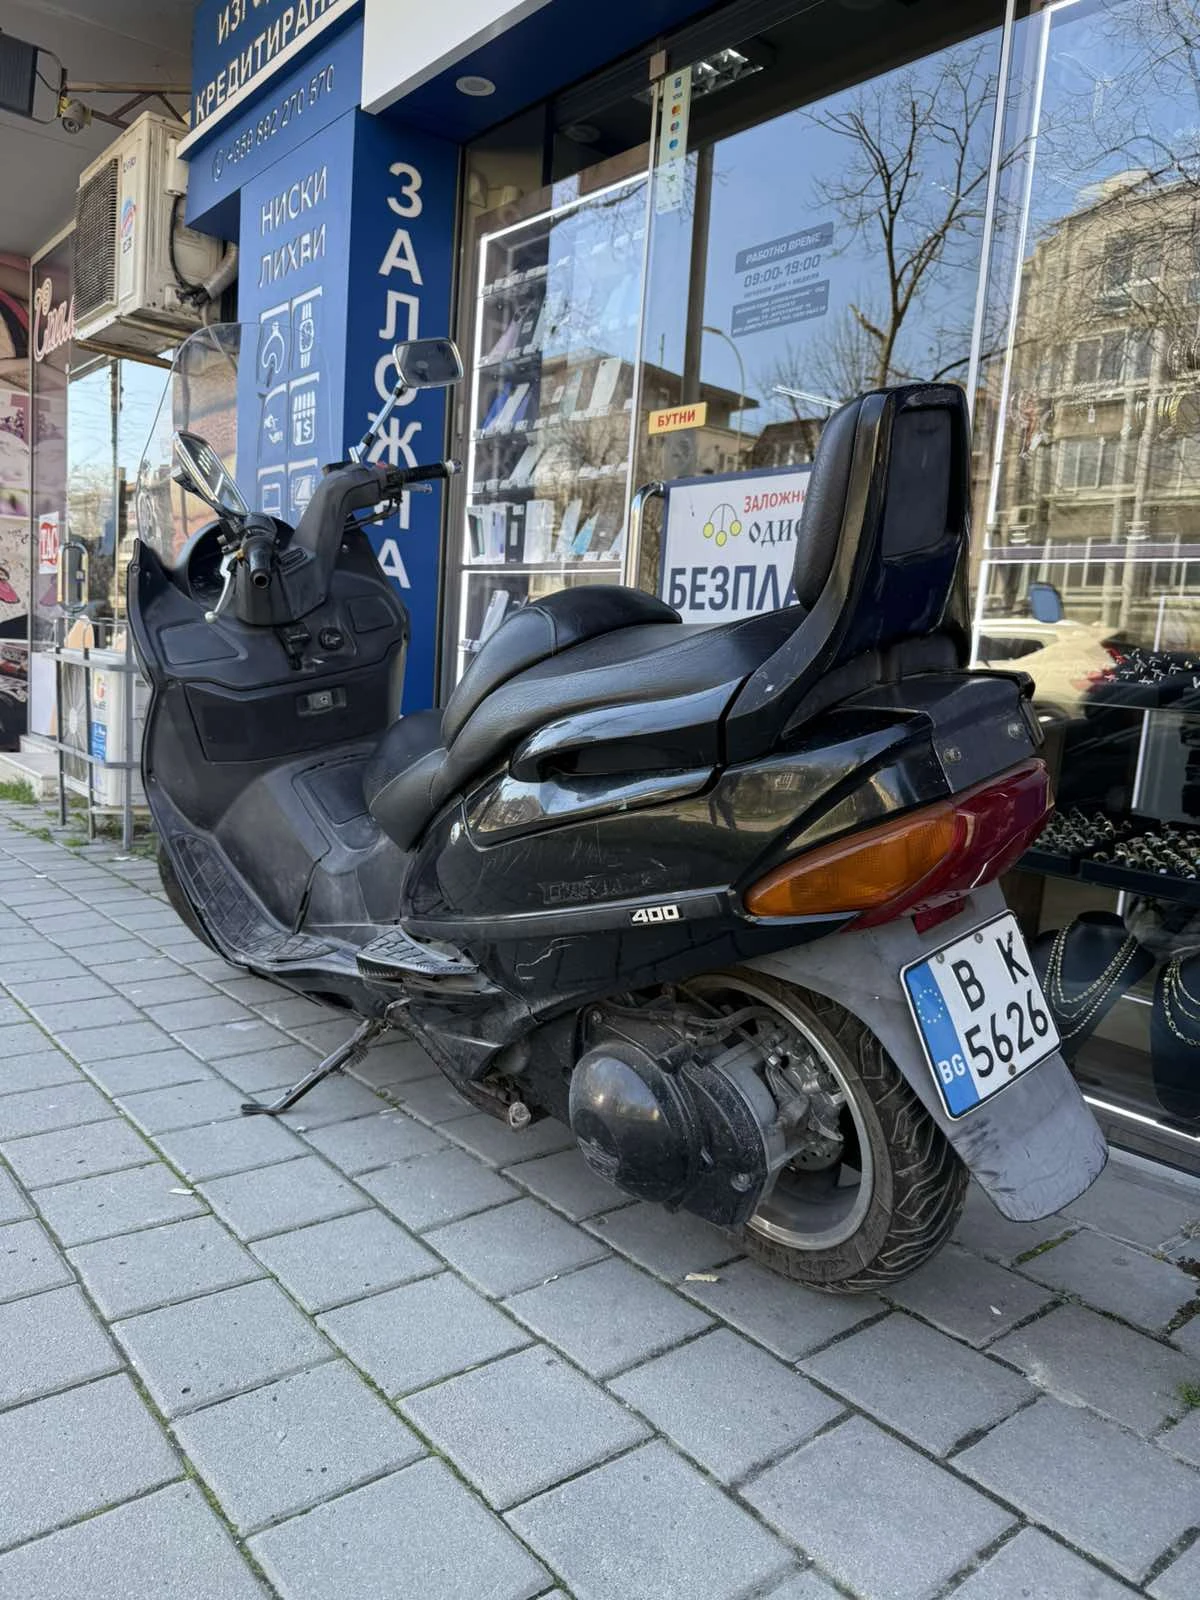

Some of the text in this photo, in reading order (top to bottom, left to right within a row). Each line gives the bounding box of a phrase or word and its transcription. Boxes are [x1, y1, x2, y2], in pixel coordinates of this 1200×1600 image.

[218, 0, 270, 45] ИЗГ
[196, 0, 336, 125] КРЕДИТИРАН
[281, 88, 305, 128] 270
[309, 64, 335, 105] 570
[261, 165, 327, 236] НИСКИ
[657, 409, 696, 428] БУТНИ
[631, 904, 680, 923] 400
[951, 931, 1029, 1012] B K
[964, 989, 1048, 1078] 5626
[938, 1053, 966, 1085] BG
